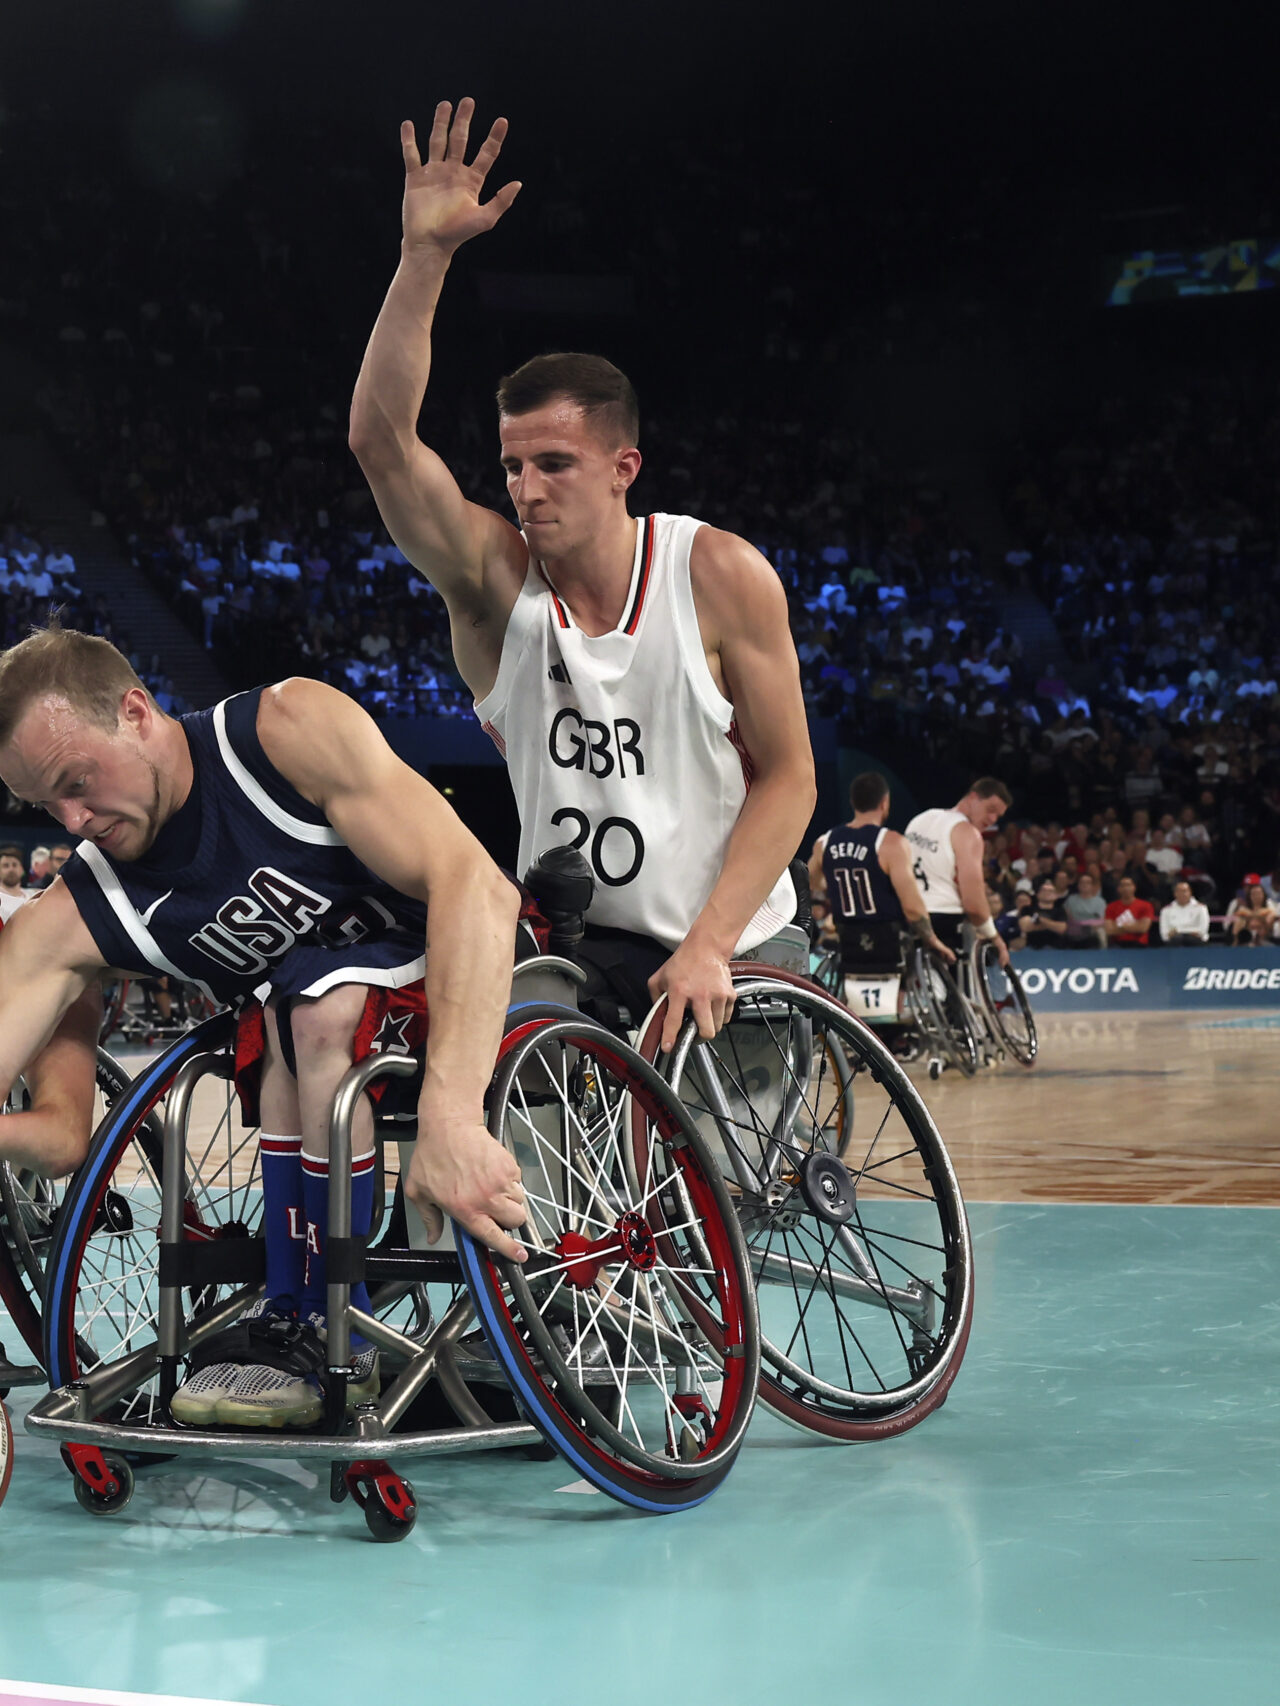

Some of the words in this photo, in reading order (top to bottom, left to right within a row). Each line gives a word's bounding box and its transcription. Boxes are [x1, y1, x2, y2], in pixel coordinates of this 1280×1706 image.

[548, 707, 645, 780] GBR
[550, 806, 645, 887] 20
[829, 841, 868, 862] SERIO
[187, 866, 333, 975] USA
[833, 867, 877, 918] 11
[861, 987, 881, 1009] 11
